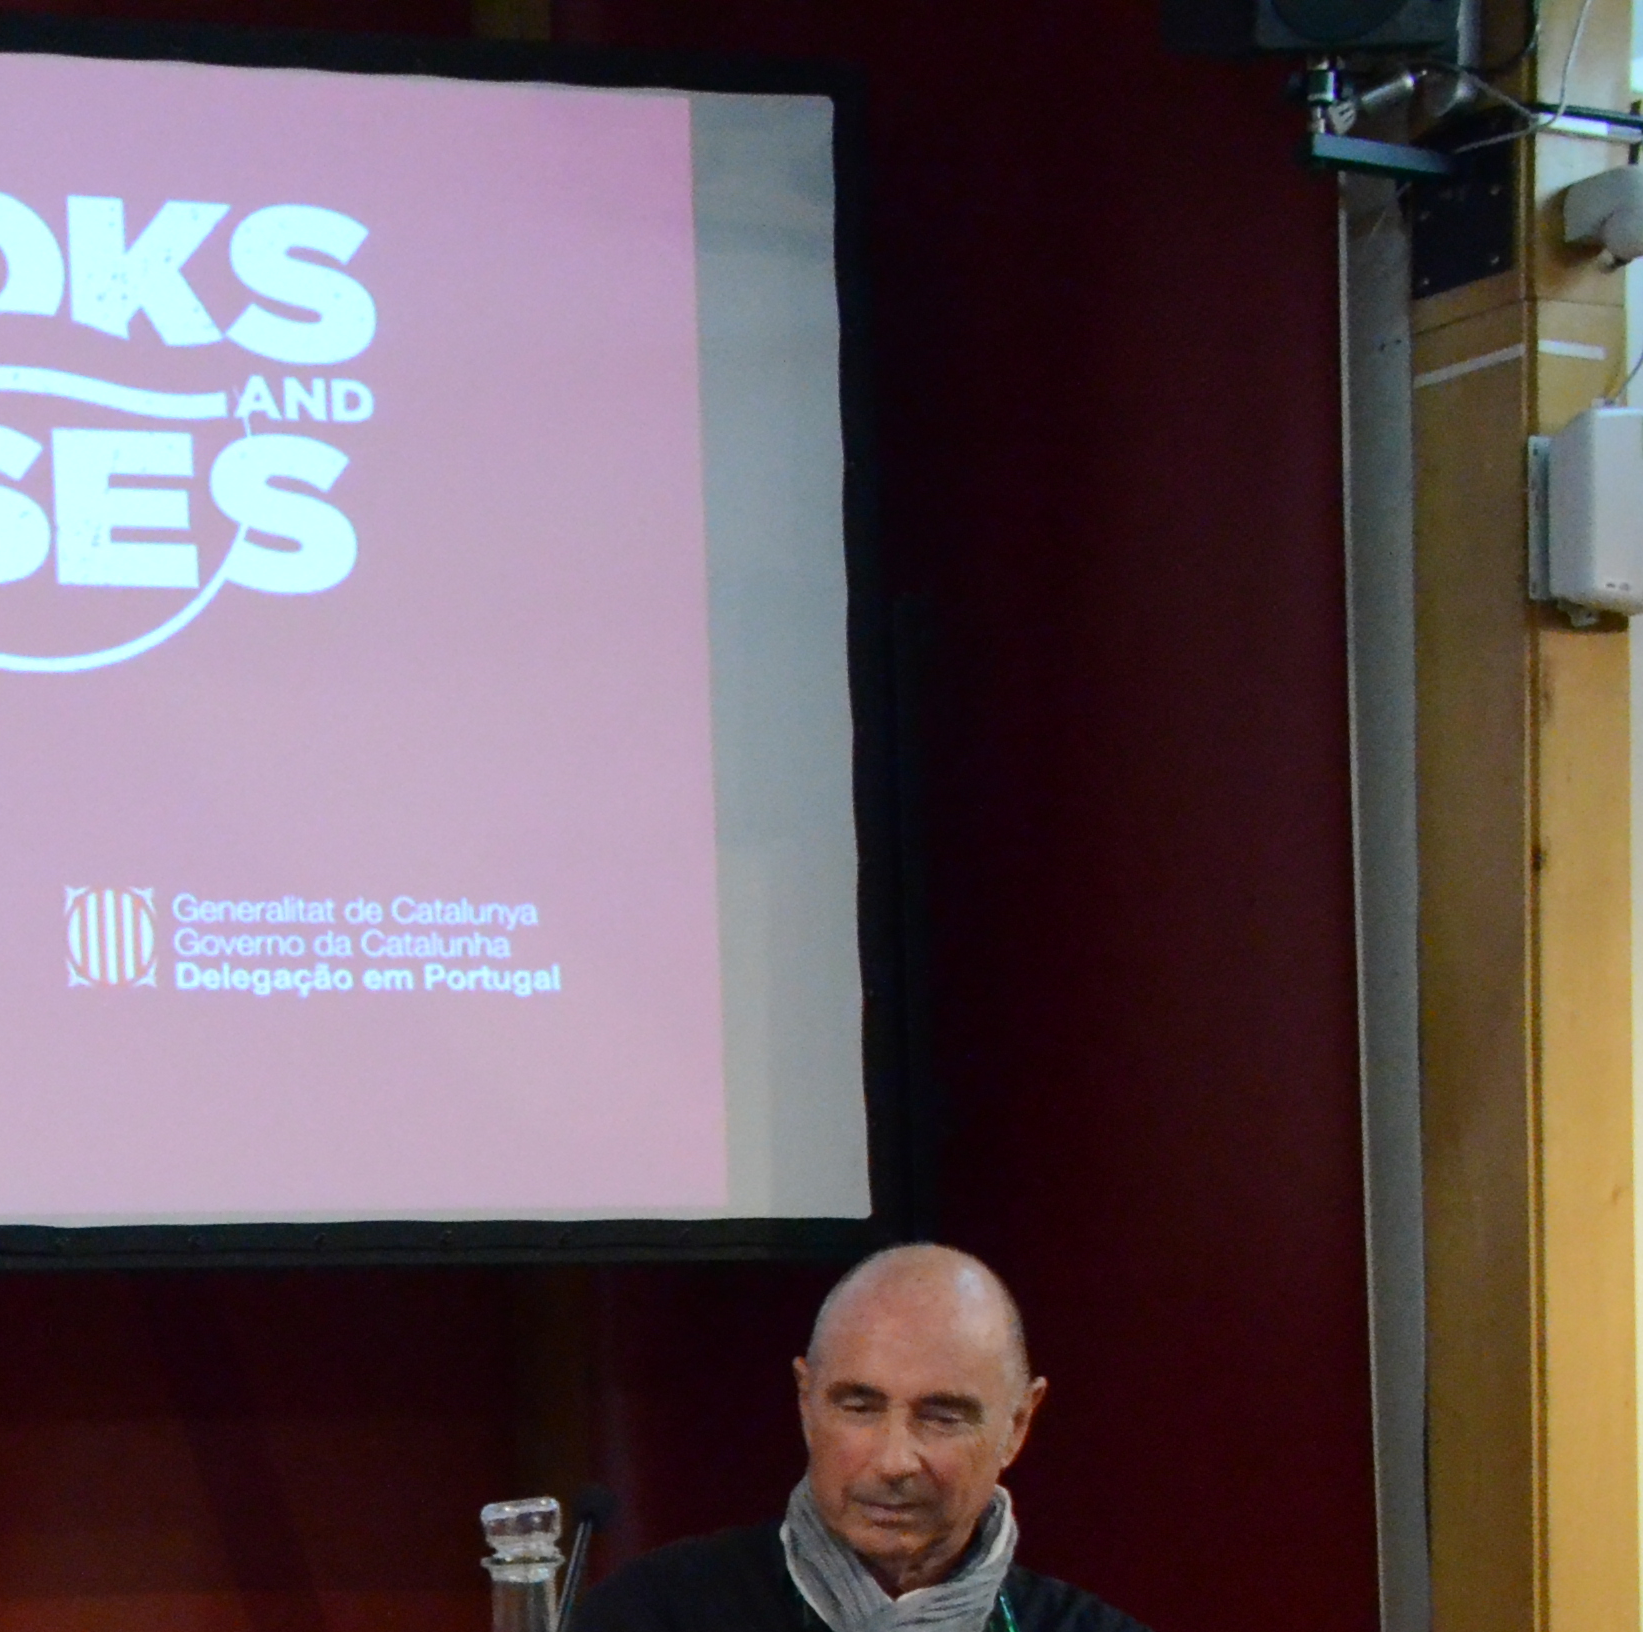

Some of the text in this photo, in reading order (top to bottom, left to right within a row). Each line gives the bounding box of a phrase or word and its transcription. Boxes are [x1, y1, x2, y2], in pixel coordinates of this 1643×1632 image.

[234, 376, 375, 423] AND
[172, 893, 538, 930] Generalitat de Catalunya
[173, 928, 511, 958] Governo da Catalunha
[175, 962, 562, 997] Delegação em Portugal
